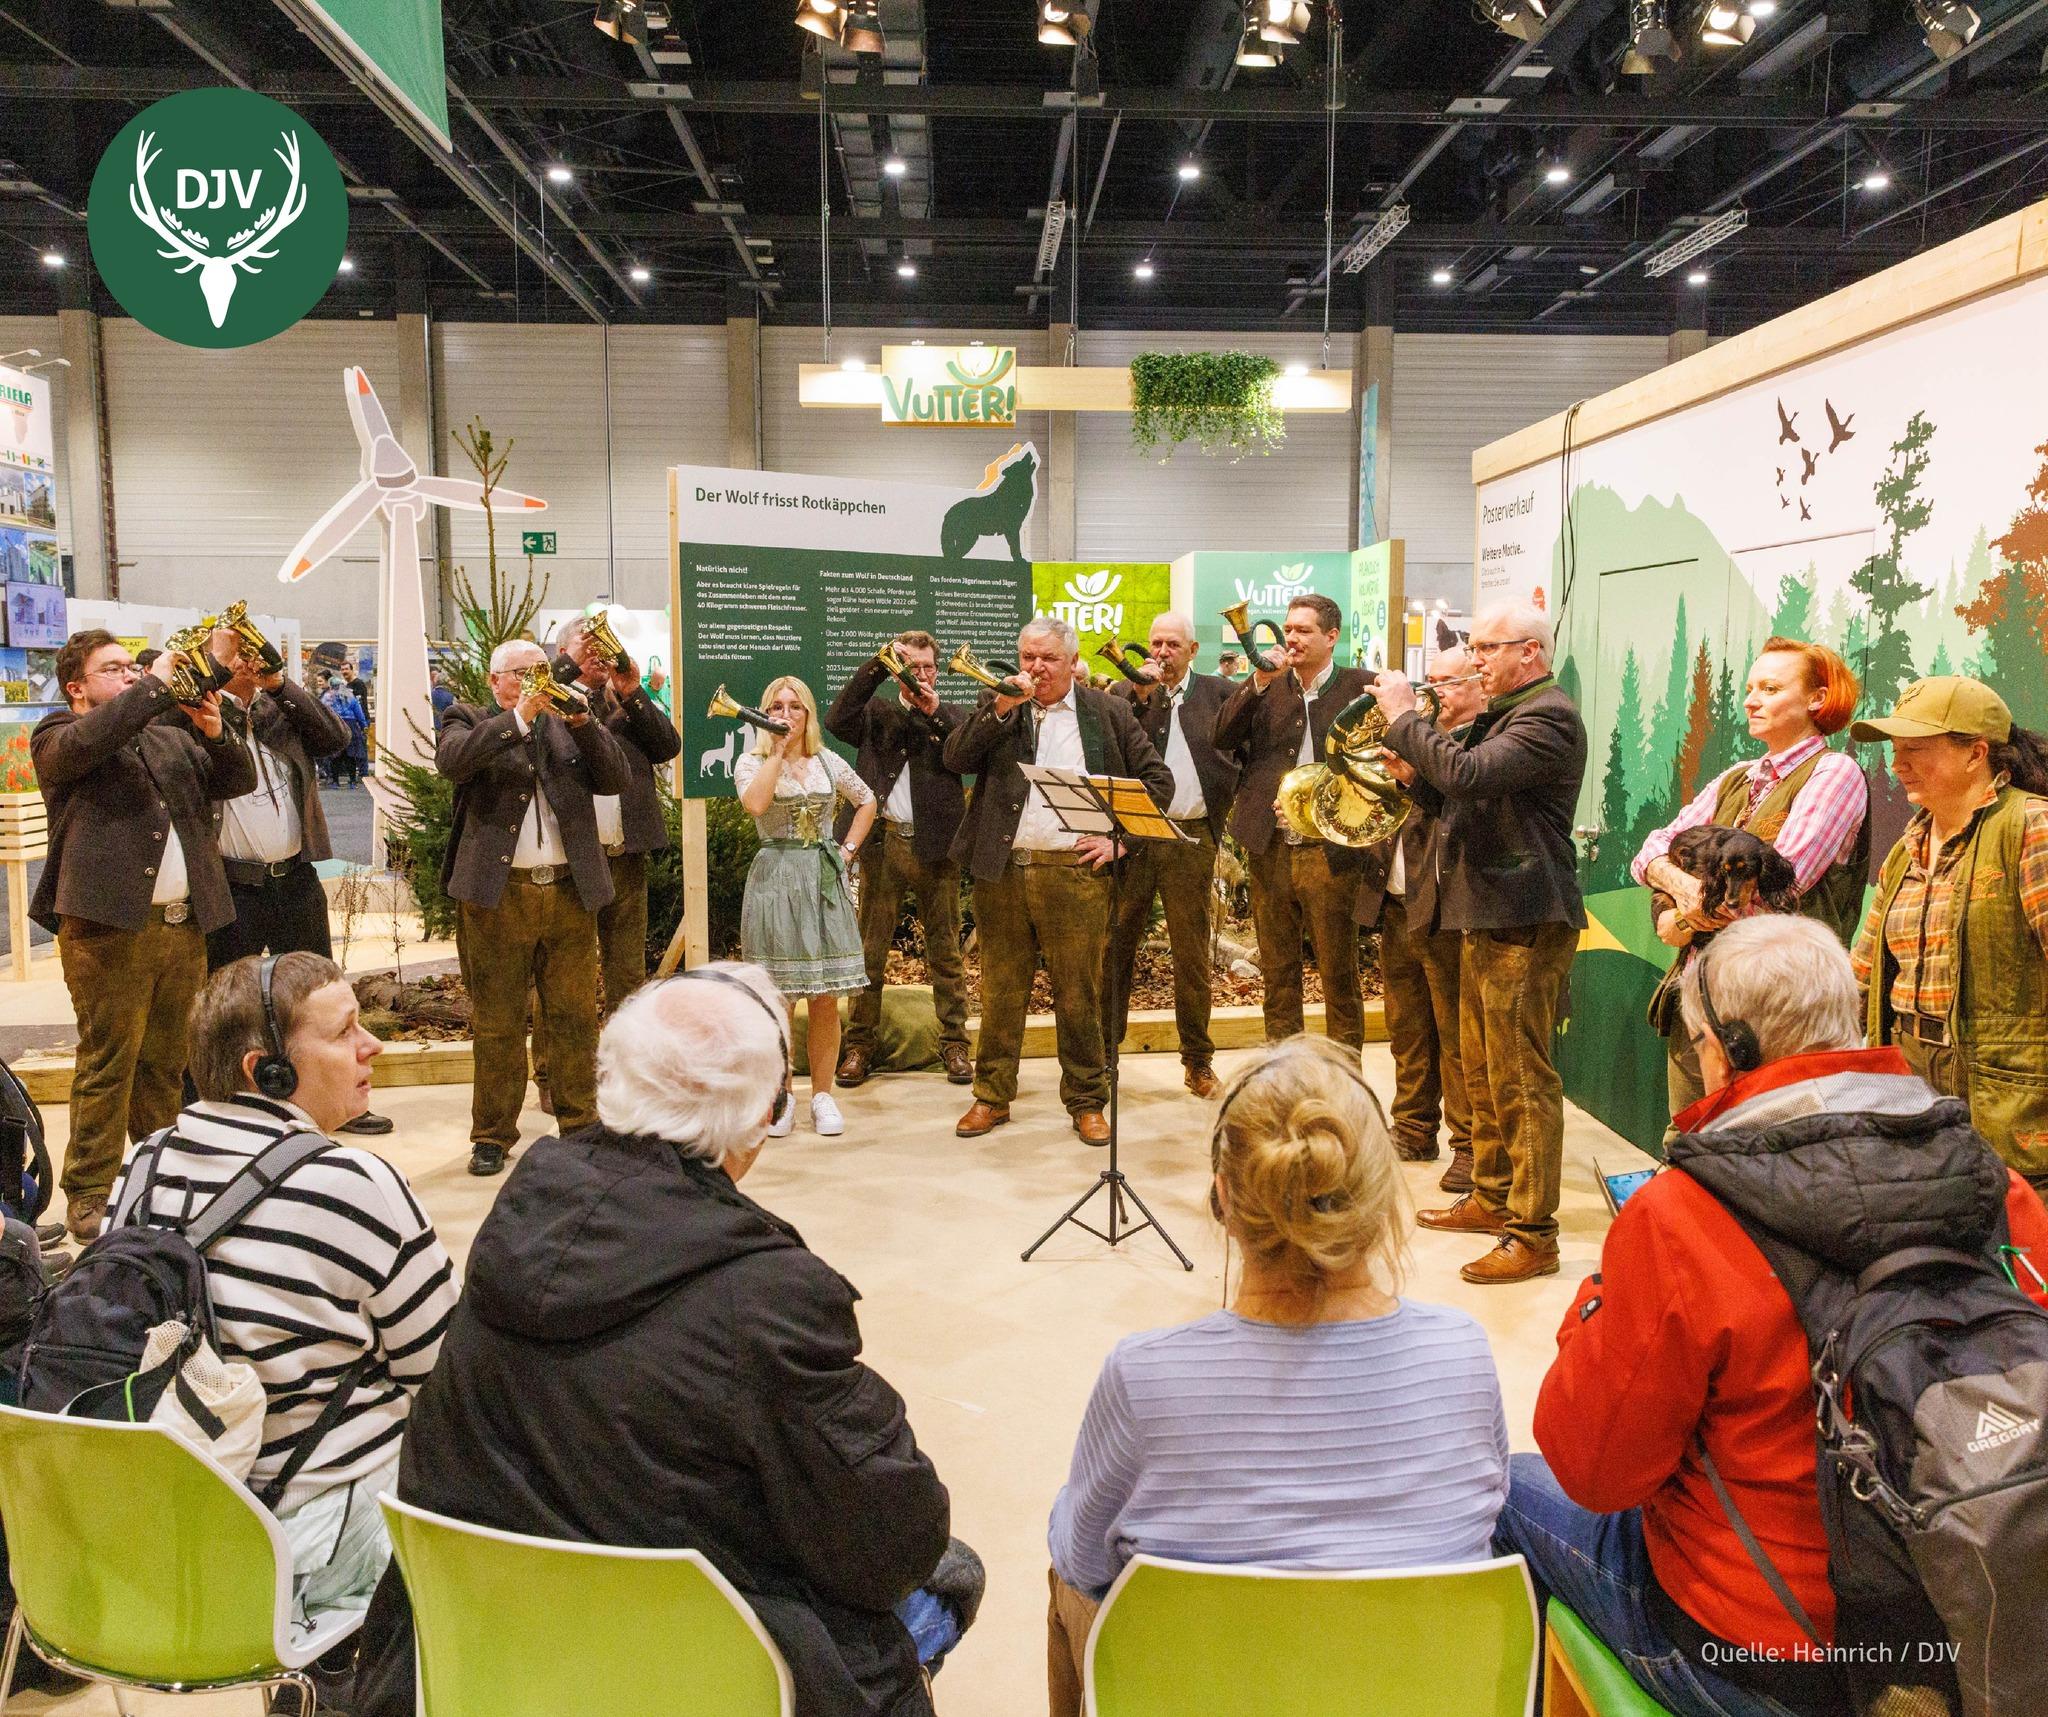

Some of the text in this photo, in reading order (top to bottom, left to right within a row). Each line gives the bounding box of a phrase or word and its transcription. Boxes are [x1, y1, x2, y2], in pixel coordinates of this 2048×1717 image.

[696, 488, 885, 515] Der Wolf frisst Rotkäppchen
[1483, 490, 1534, 524] Posterverkauf
[1481, 547, 1501, 561] Weitere
[696, 565, 727, 573] Natürlich
[878, 573, 913, 581] Deutschland
[759, 584, 791, 592] Spielregeln
[706, 602, 738, 610] Kilogramm
[1967, 1418, 2040, 1453] GREGORY
